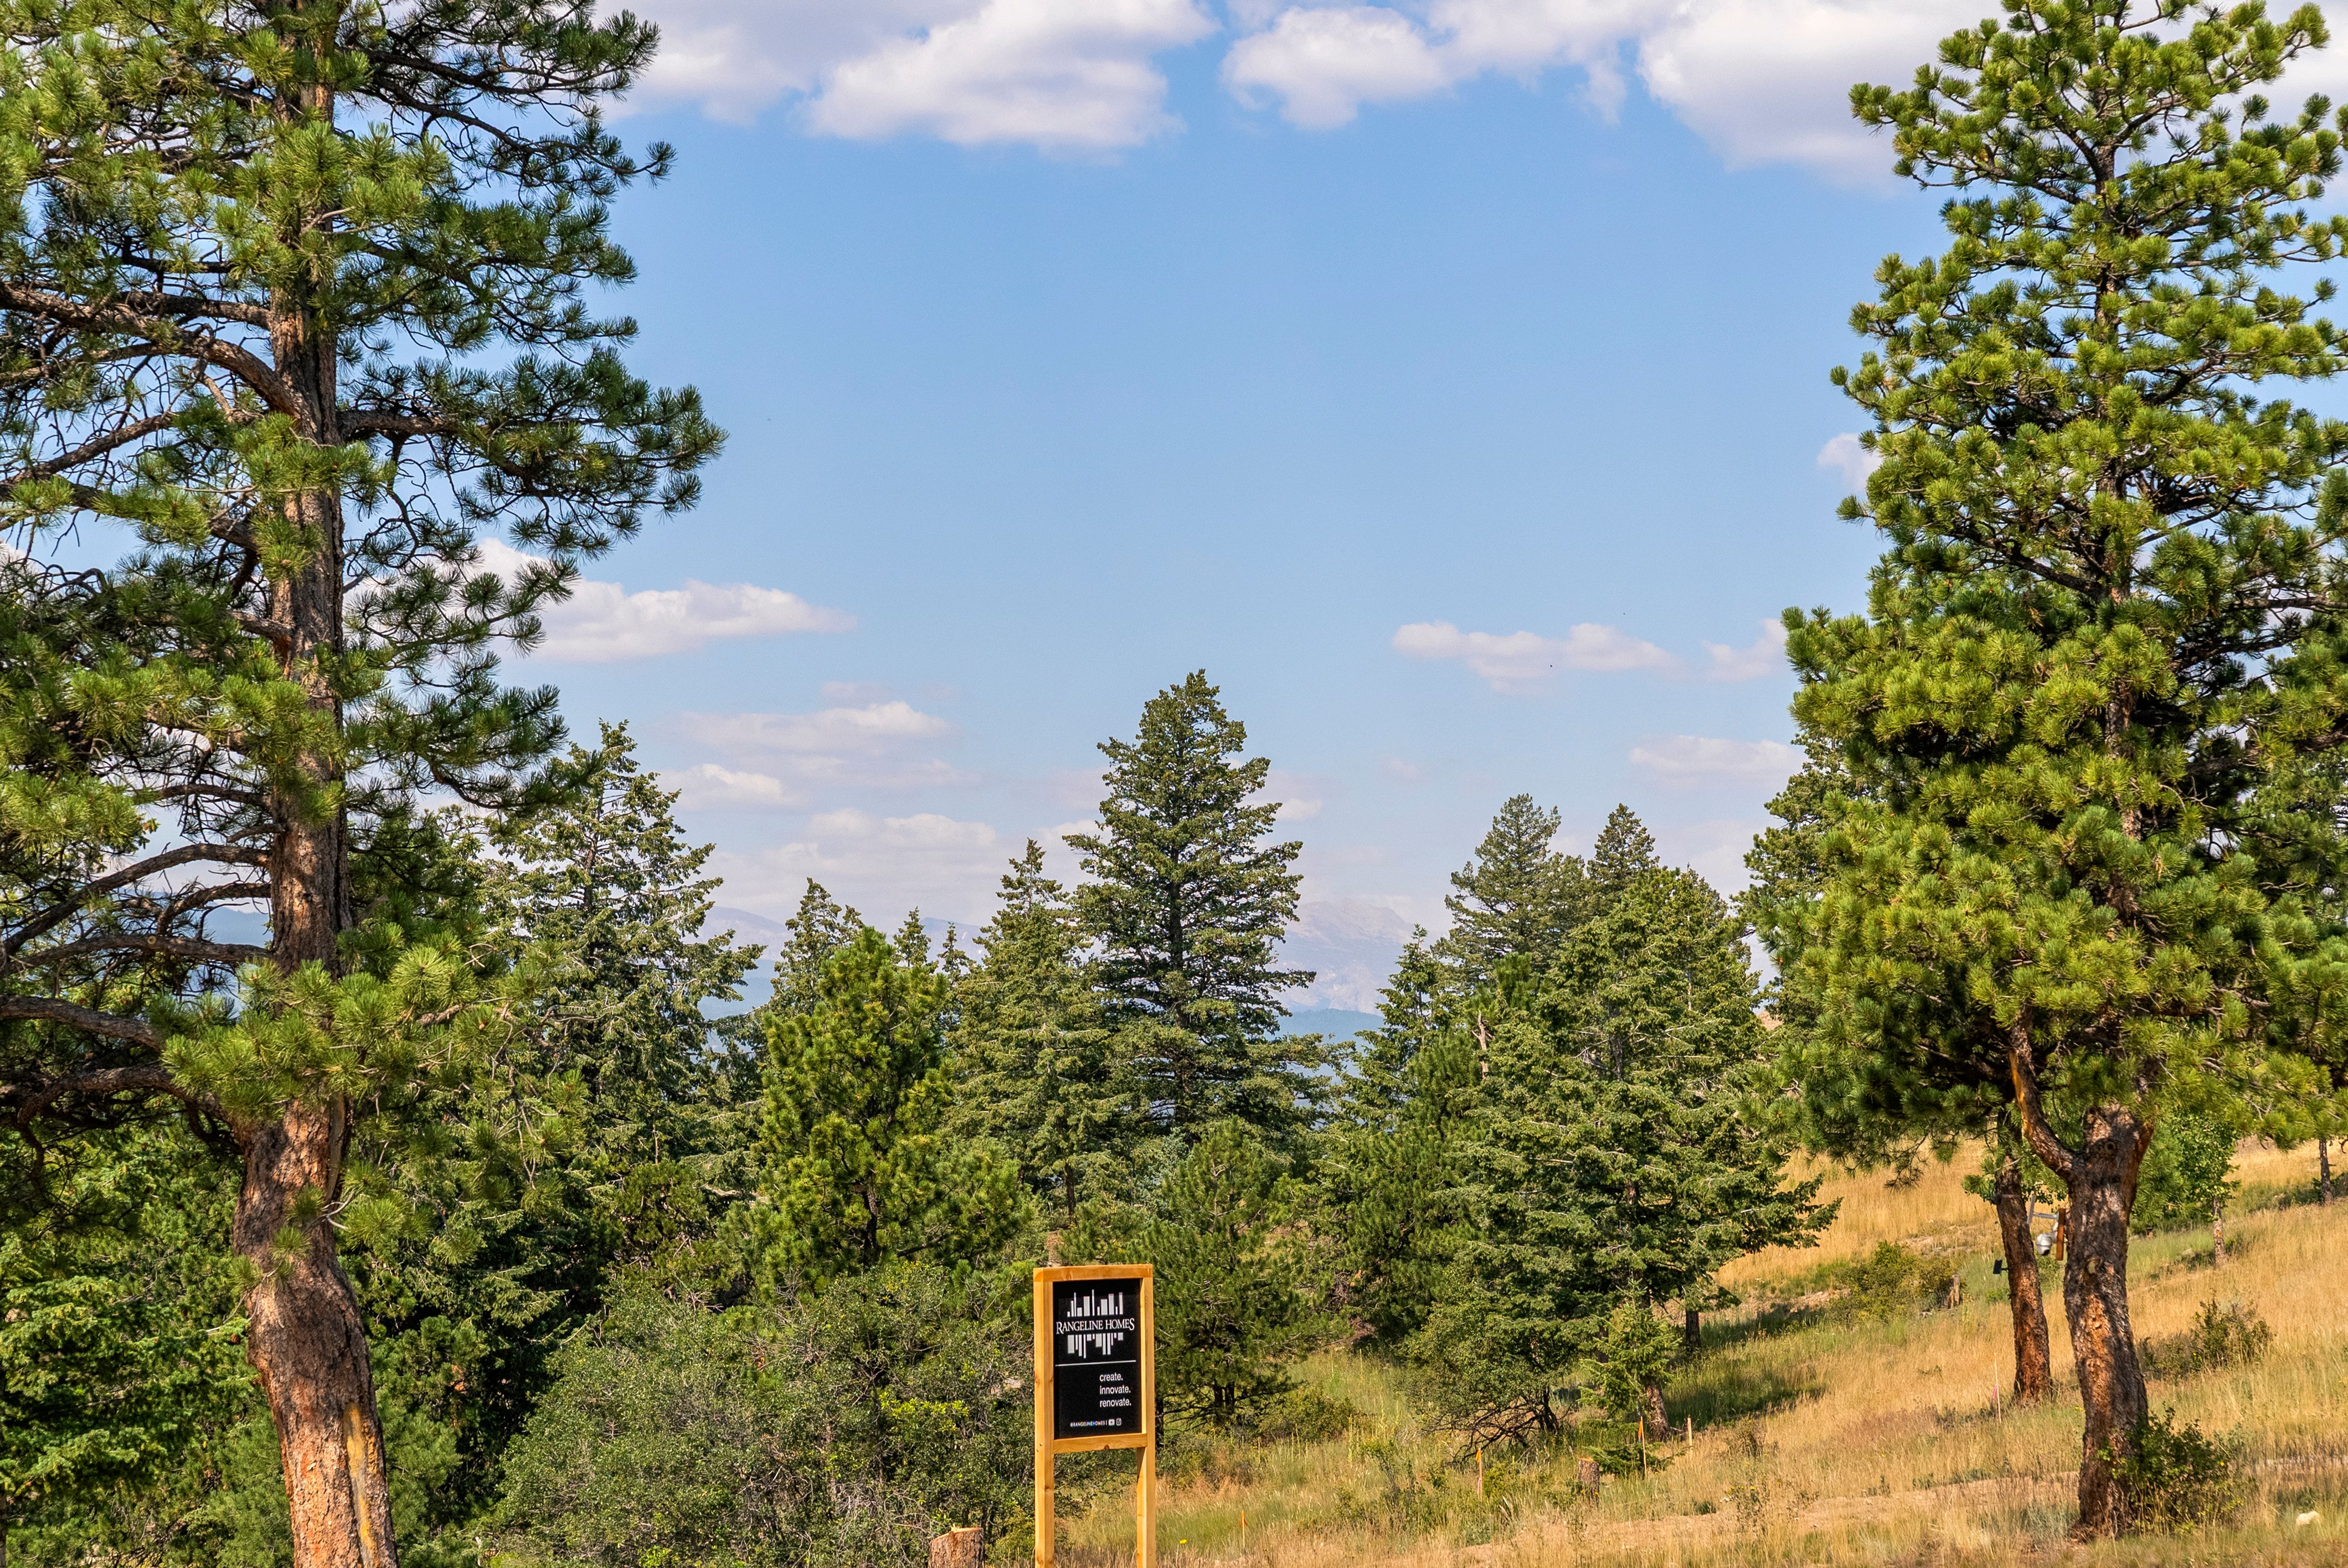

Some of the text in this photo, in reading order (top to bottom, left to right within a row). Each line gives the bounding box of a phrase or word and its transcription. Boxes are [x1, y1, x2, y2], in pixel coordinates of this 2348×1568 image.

[1056, 1318, 1135, 1334] RANGELINE HOMES
[1099, 1372, 1123, 1381] create.
[1099, 1385, 1131, 1395] innovate.
[1100, 1397, 1131, 1407] renovate.
